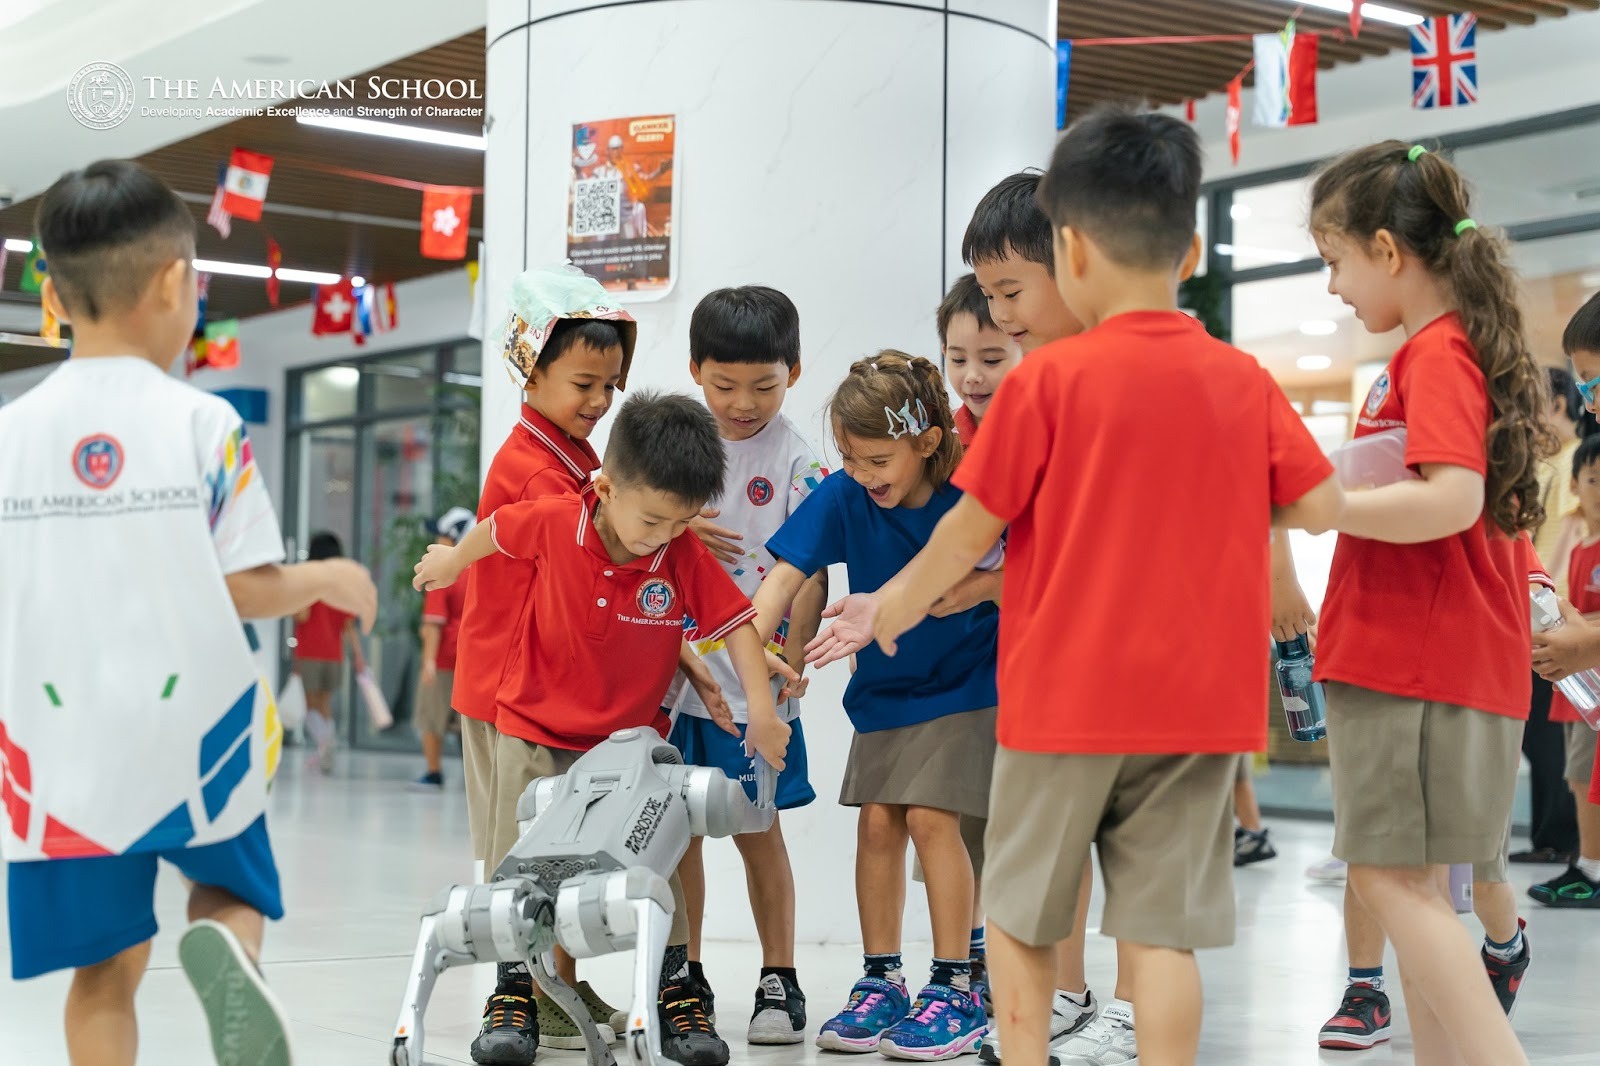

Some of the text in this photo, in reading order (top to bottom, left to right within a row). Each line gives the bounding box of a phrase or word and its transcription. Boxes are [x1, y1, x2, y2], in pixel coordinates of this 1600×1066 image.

[616, 613, 631, 622] THE
[630, 617, 664, 625] AMERICAN
[629, 797, 662, 847] ROBOSTORE
